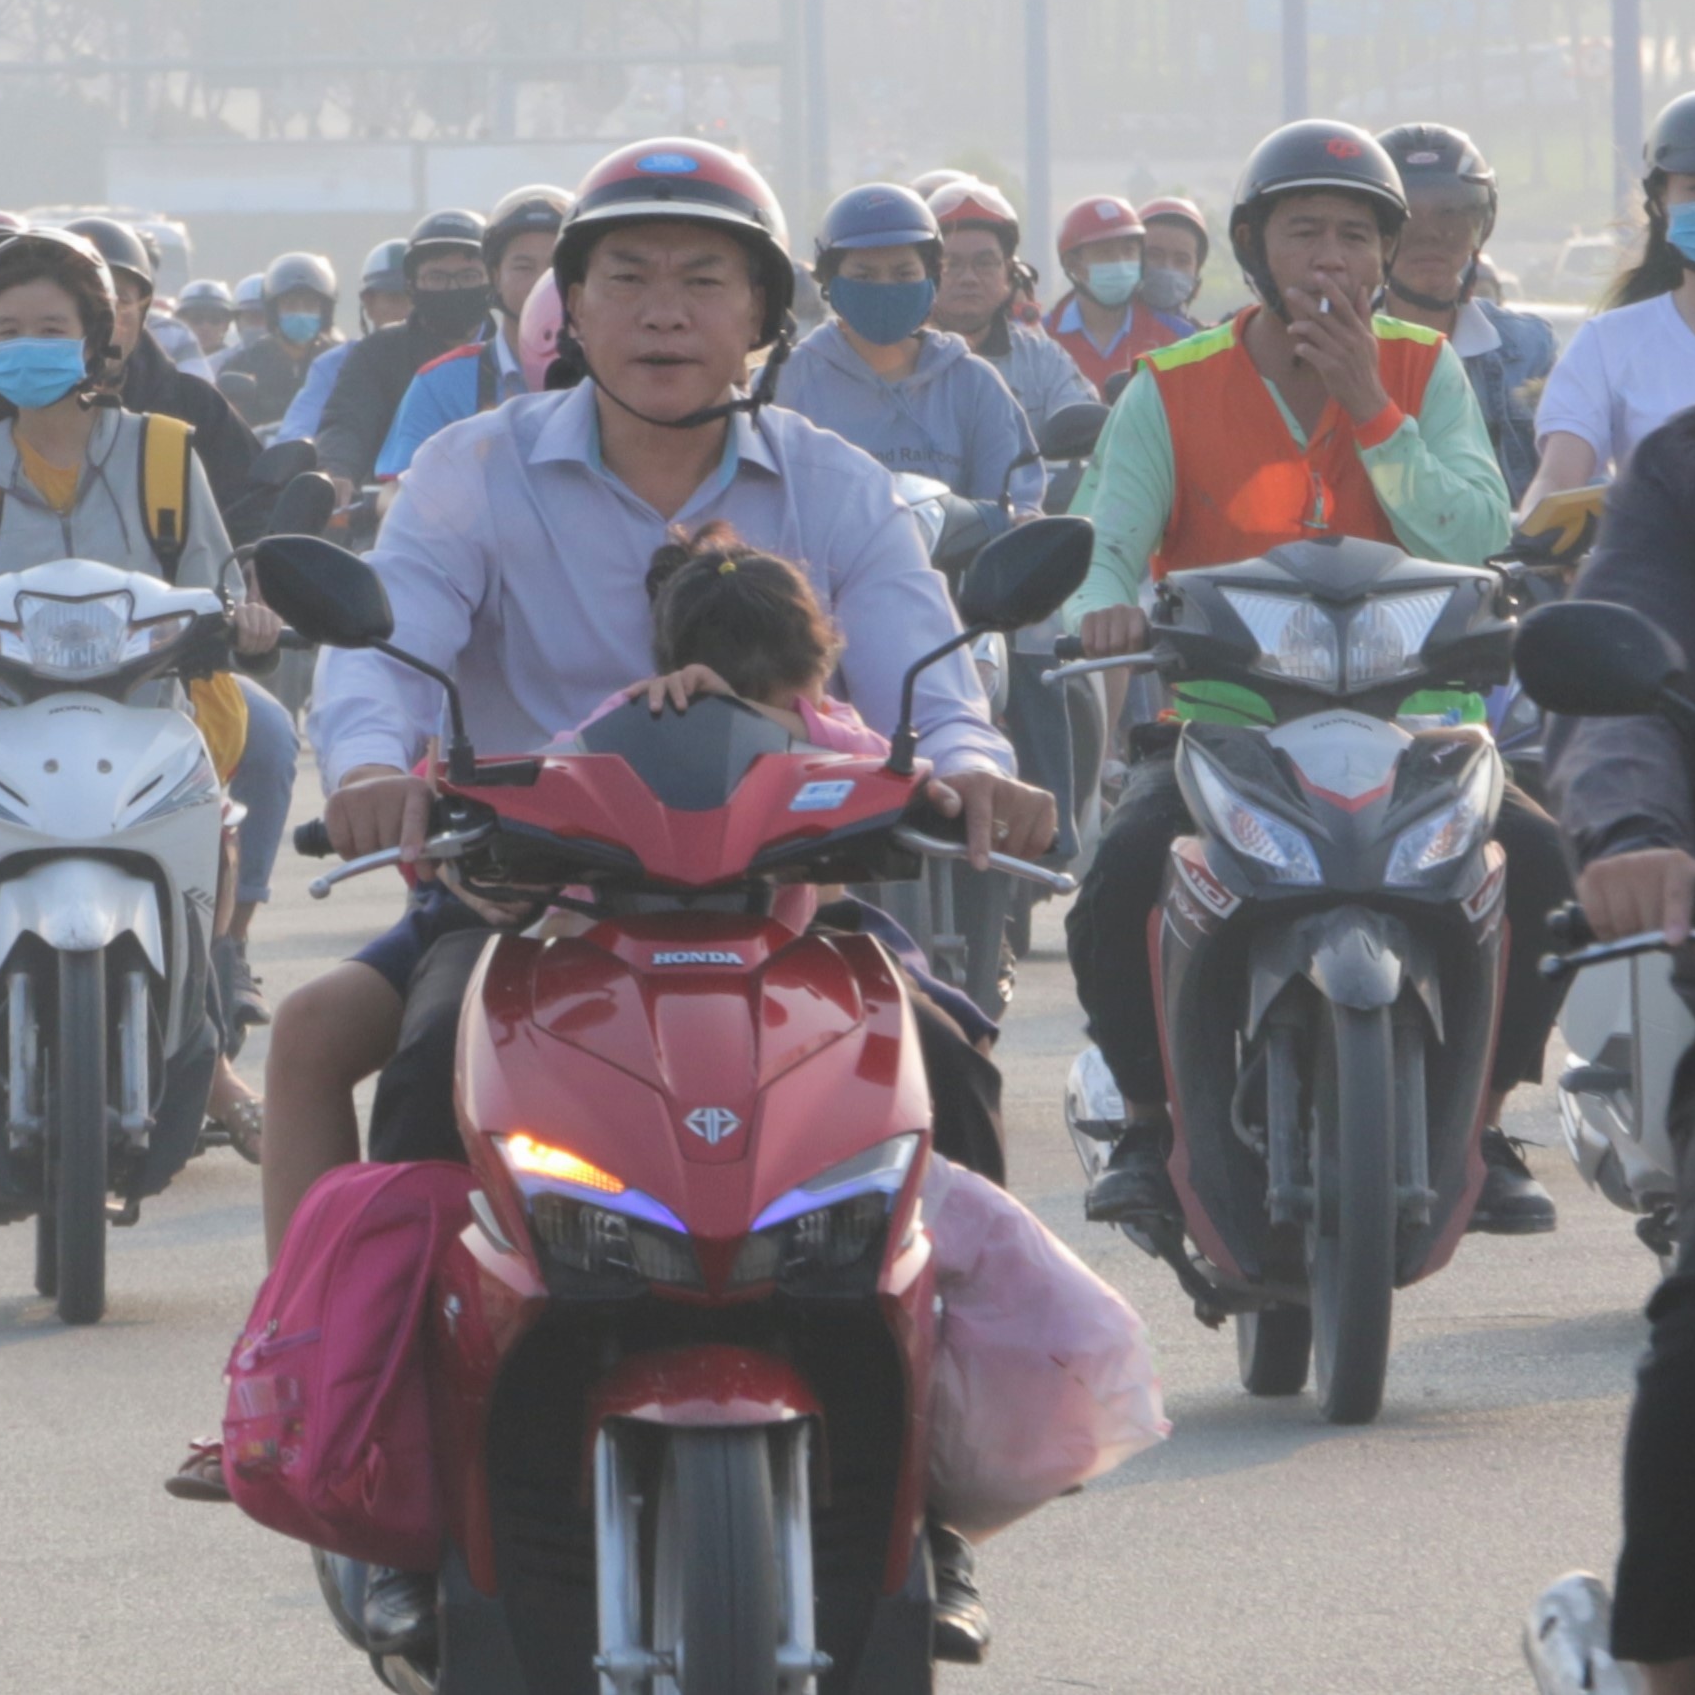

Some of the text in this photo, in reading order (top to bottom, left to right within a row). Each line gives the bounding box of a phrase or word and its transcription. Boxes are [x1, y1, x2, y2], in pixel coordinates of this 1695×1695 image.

[48, 705, 103, 715] HONDA
[1312, 716, 1374, 732] HONDA
[652, 951, 746, 966] HONDA
